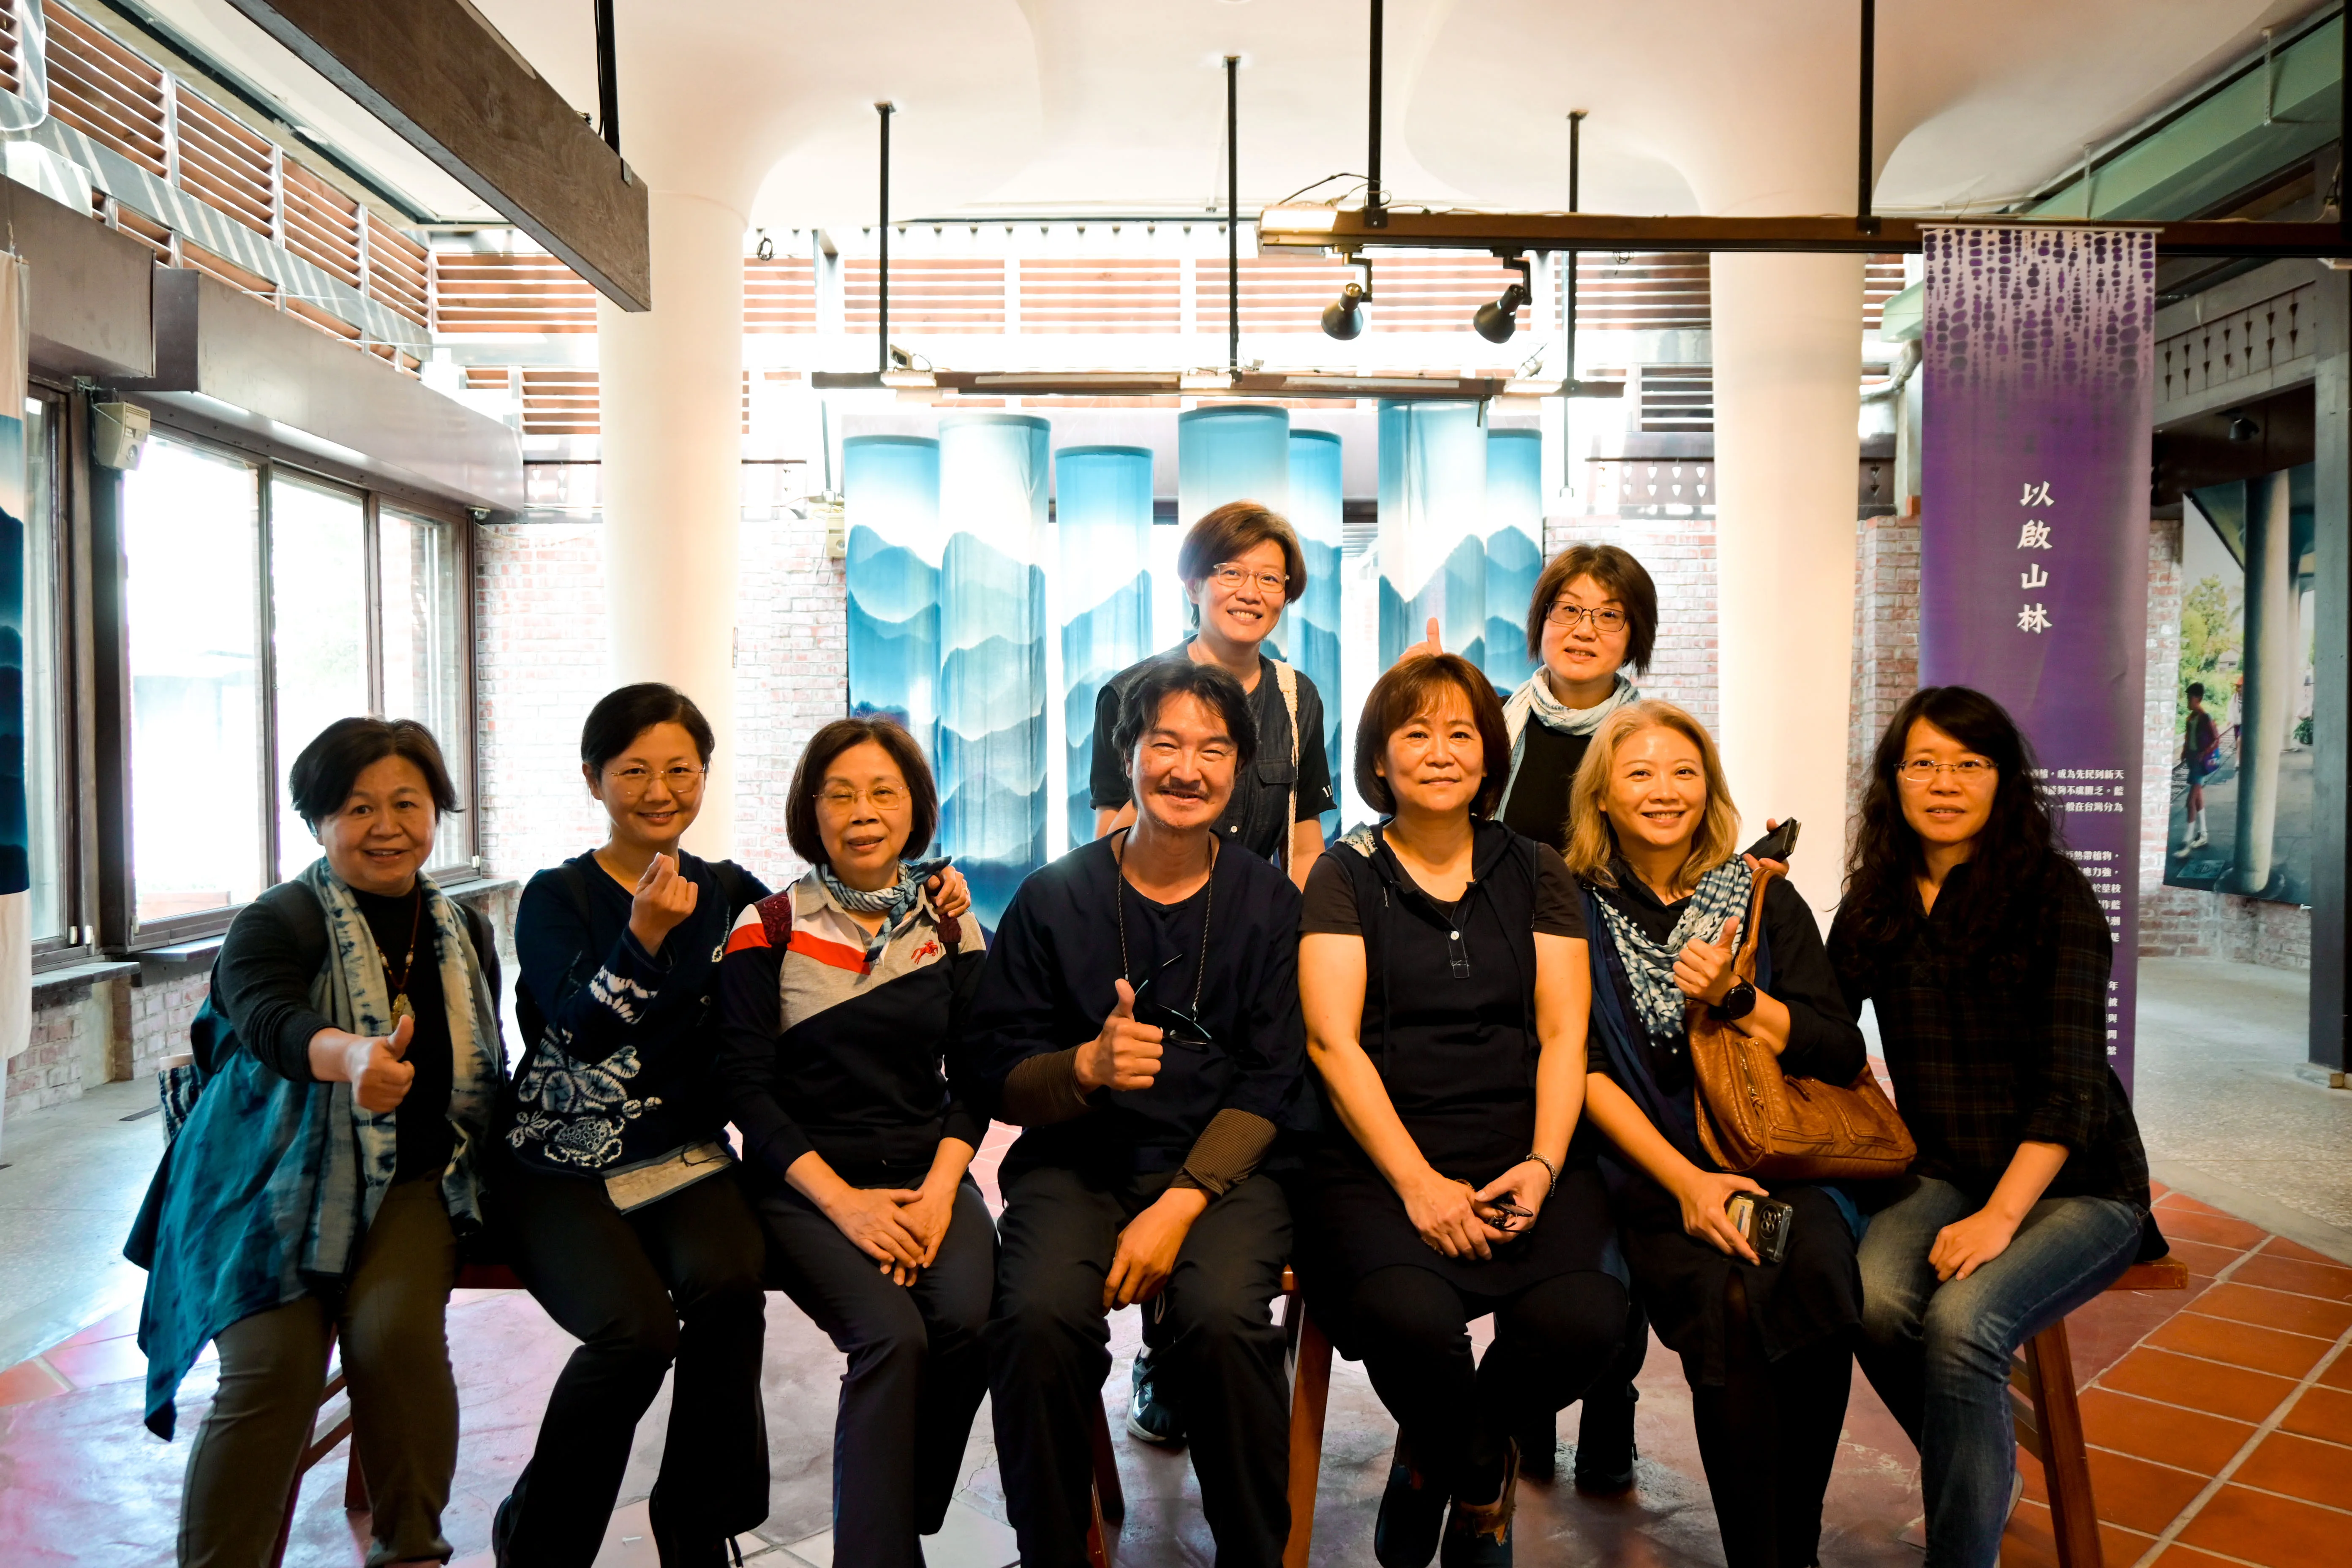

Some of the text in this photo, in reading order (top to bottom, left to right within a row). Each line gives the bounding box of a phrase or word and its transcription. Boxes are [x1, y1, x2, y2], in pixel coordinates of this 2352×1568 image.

[2017, 480, 2054, 634] 以啟山林
[2108, 981, 2119, 991] 年
